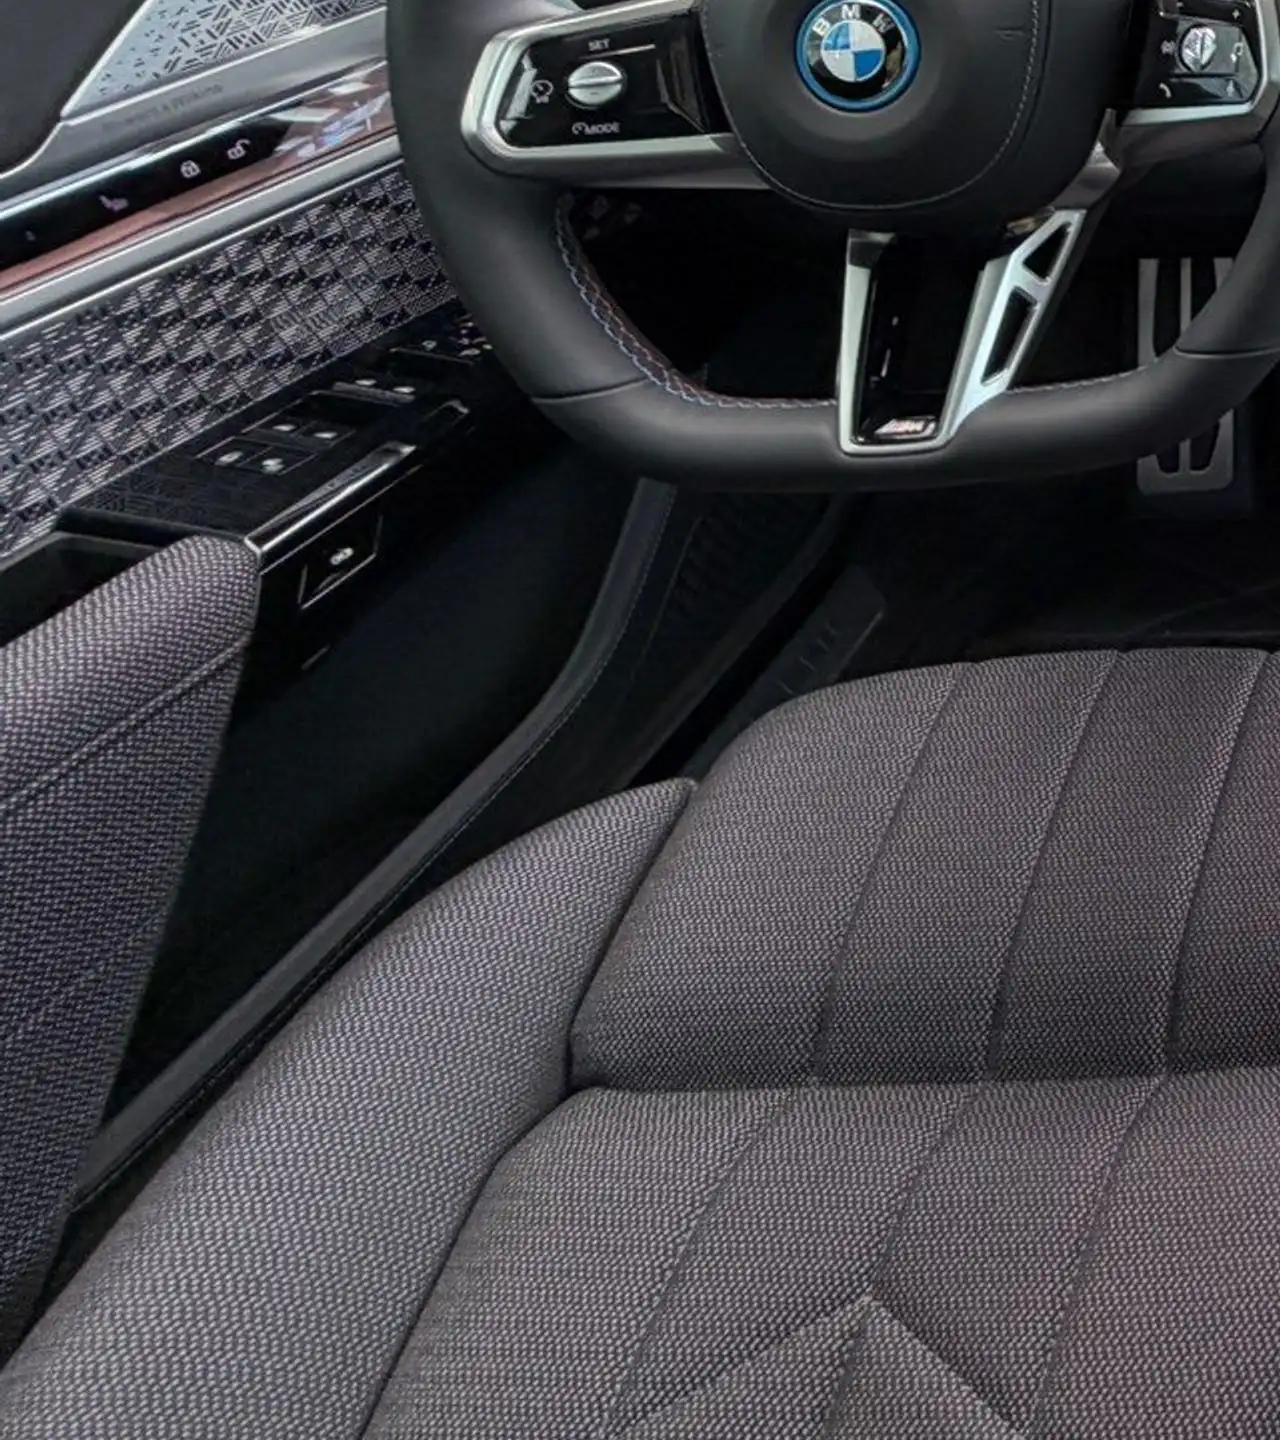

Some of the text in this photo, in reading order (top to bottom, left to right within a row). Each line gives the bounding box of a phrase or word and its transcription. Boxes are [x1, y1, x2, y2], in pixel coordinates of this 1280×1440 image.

[812, 4, 894, 36] BMW
[588, 39, 610, 51] SET
[584, 122, 620, 136] MODE
